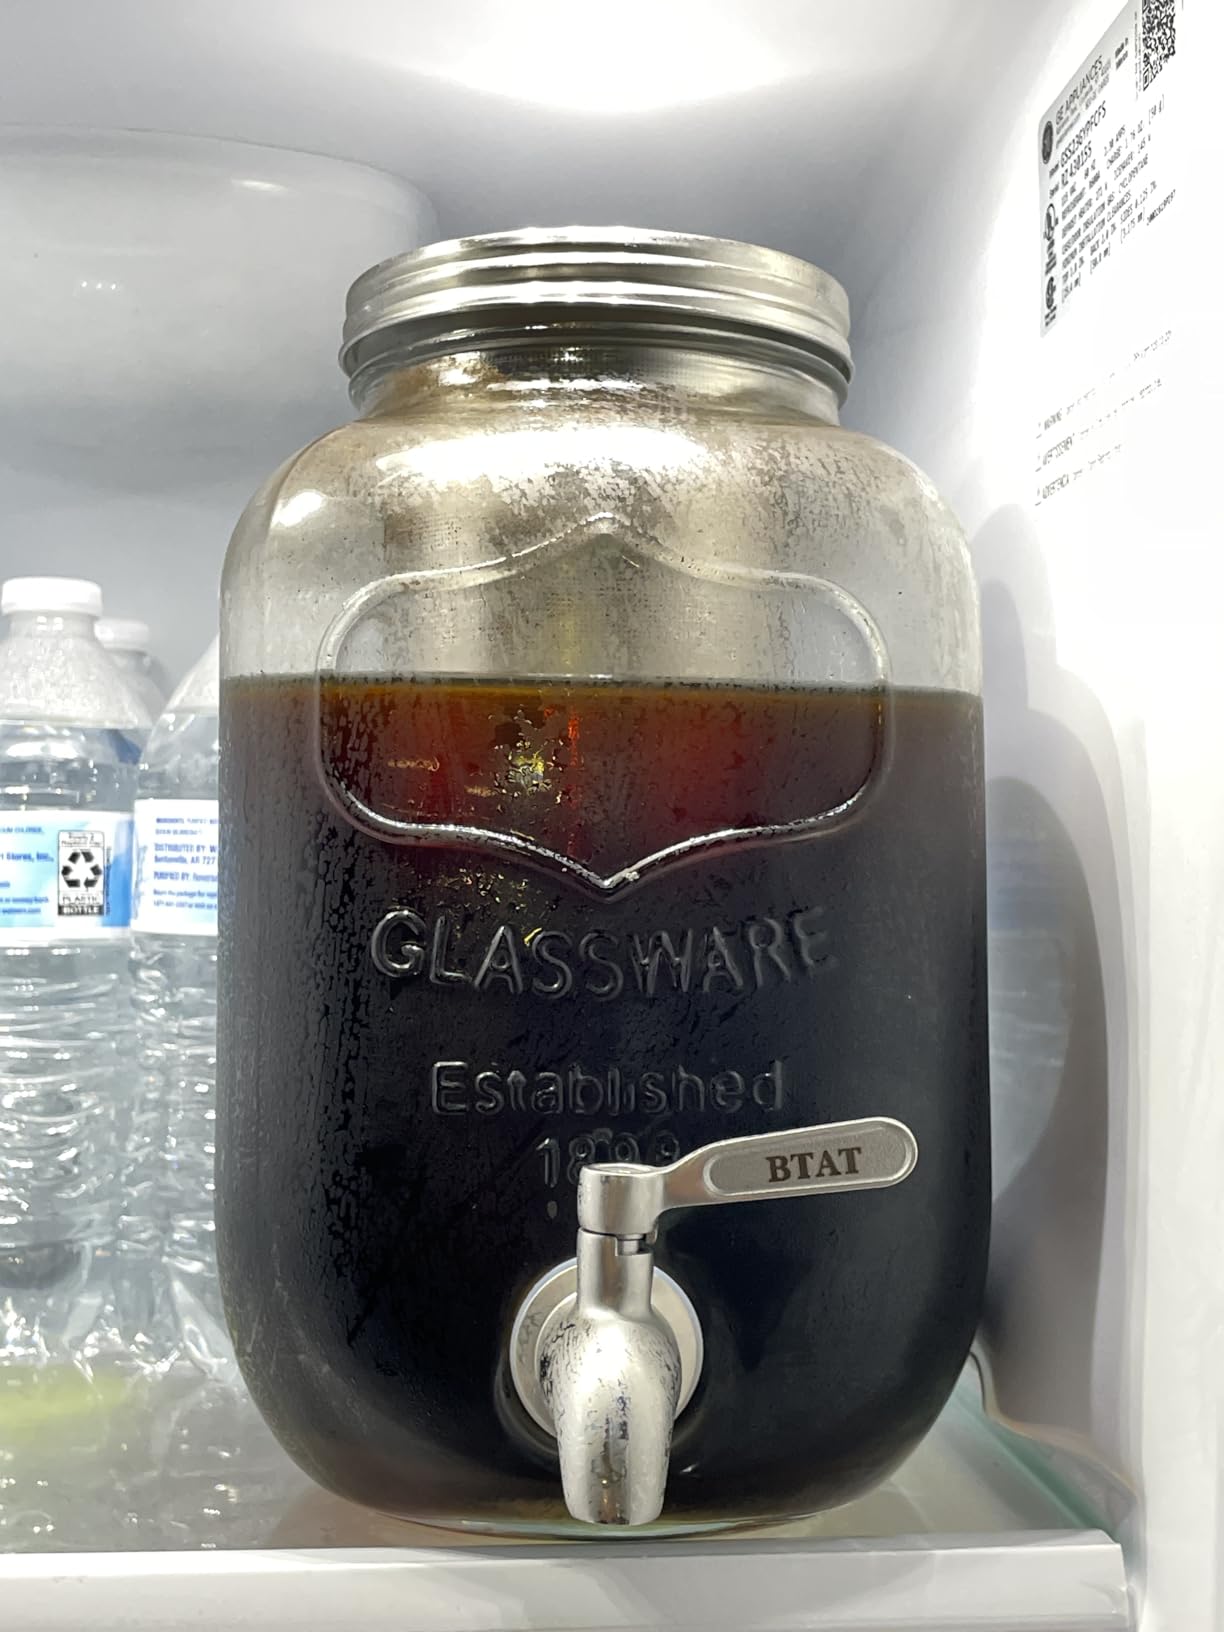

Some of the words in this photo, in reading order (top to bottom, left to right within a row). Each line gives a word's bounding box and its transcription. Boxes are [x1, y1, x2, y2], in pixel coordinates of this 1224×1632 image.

[368, 905, 838, 1000] GLASSWARE
[430, 1059, 786, 1117] Established
[765, 1146, 863, 1184] BTAT
